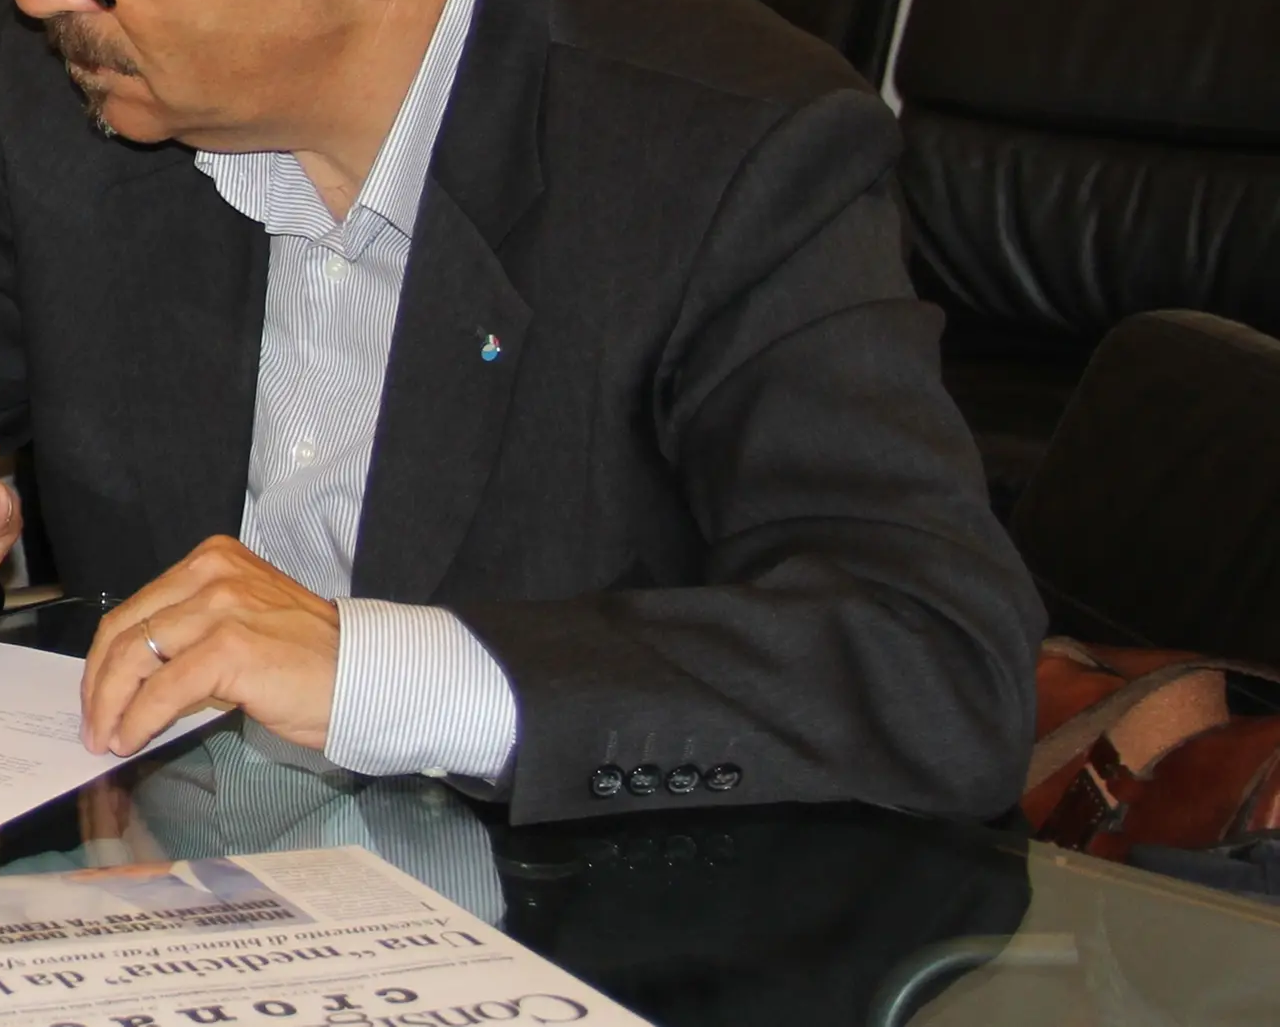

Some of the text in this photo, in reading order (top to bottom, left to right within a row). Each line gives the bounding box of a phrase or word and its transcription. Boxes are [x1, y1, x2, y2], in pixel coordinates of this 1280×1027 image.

[103, 912, 148, 923] PAT
[0, 931, 64, 943] DOPO
[294, 918, 451, 941] Assestamento
[168, 938, 260, 955] bilancio
[266, 934, 288, 945] di
[376, 931, 482, 953] Una
[29, 952, 106, 965] nuovo
[104, 945, 375, 986] “medicina”
[23, 969, 83, 989] da
